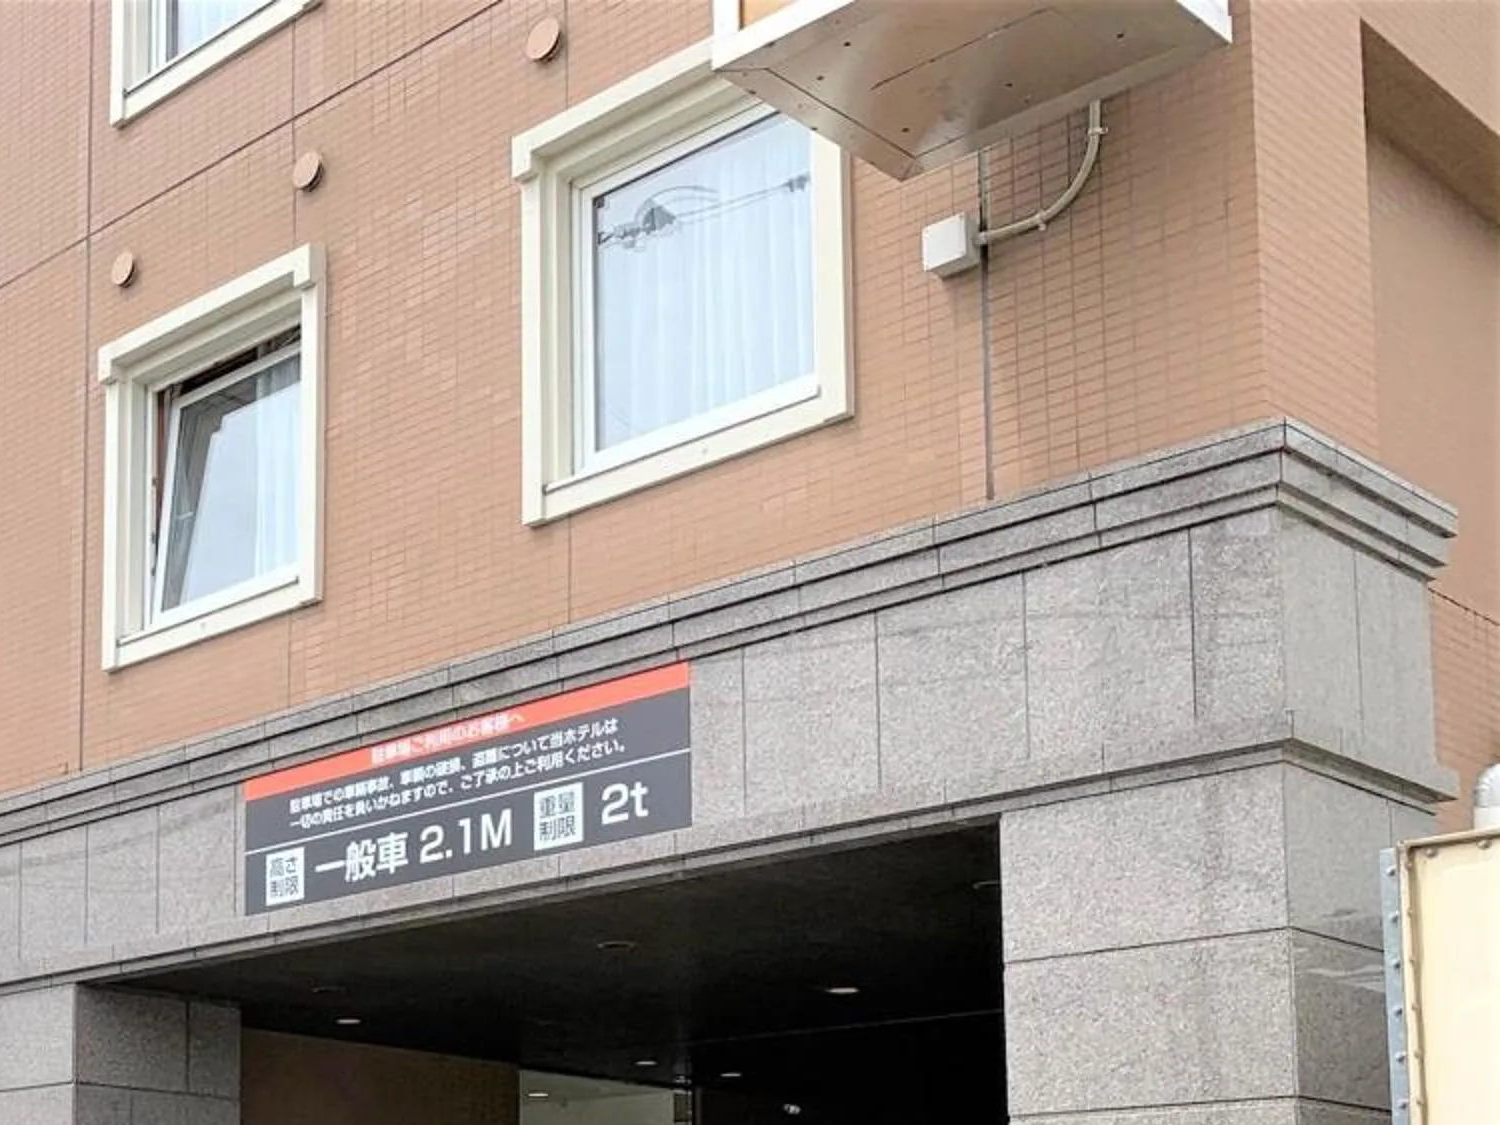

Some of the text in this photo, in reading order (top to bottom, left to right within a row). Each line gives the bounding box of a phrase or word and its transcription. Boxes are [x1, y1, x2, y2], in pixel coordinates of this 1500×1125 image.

[539, 789, 576, 818] 重量
[601, 780, 649, 825] 2t
[539, 814, 576, 842] 制限
[315, 808, 513, 883] 一般車 2.1M
[269, 856, 297, 878] 高さ
[269, 875, 299, 899] 制限
